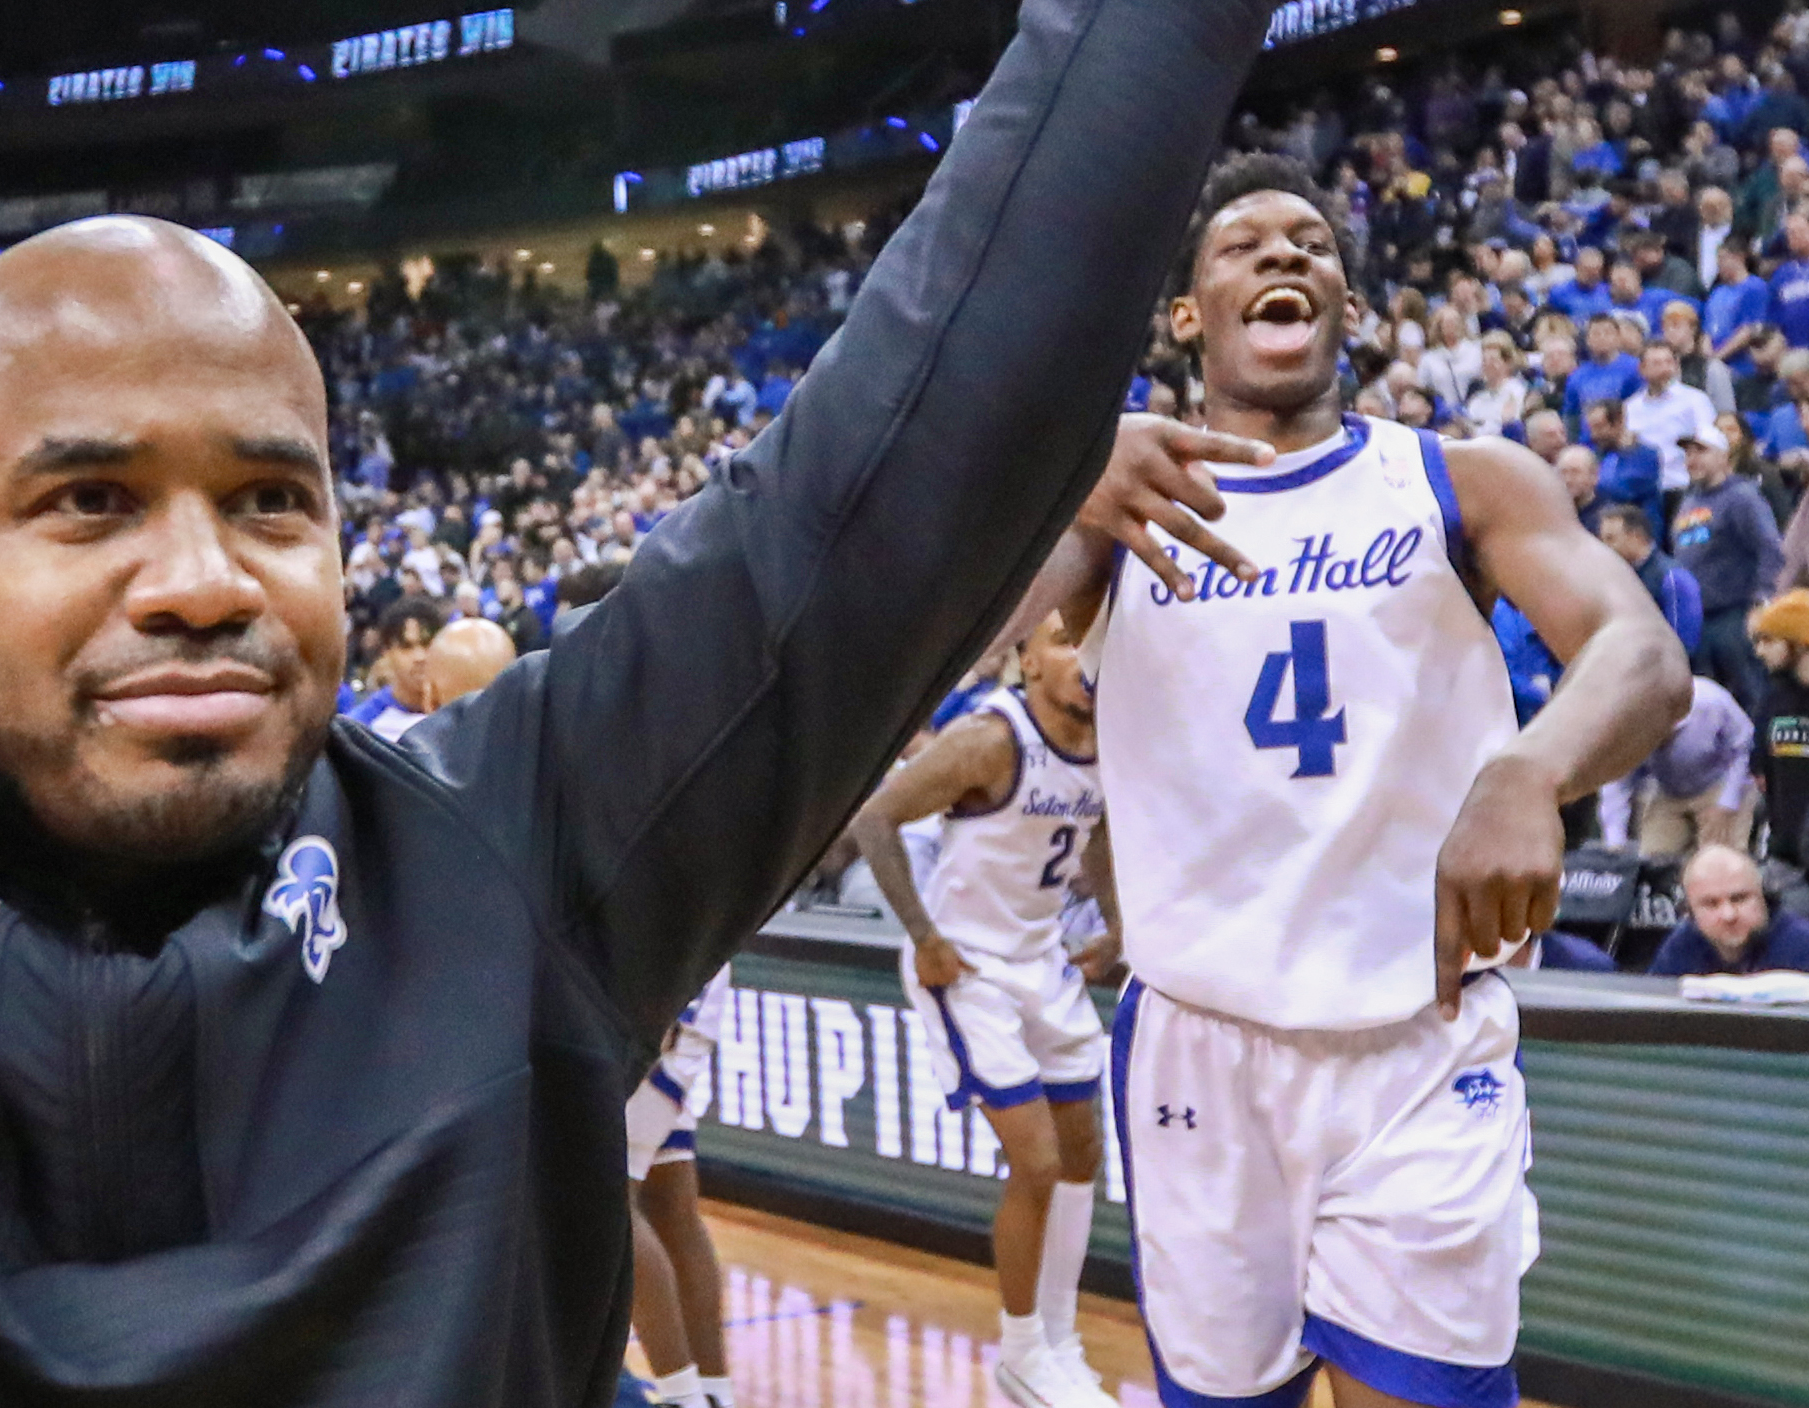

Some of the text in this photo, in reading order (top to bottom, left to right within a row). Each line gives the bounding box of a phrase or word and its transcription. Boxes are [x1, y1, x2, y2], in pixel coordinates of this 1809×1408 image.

[331, 8, 514, 78] PIRATES WIN
[47, 59, 197, 106] PIRATES WIN
[1288, 526, 1423, 594] Hall
[1244, 619, 1348, 780] 4
[1039, 824, 1079, 890] 2
